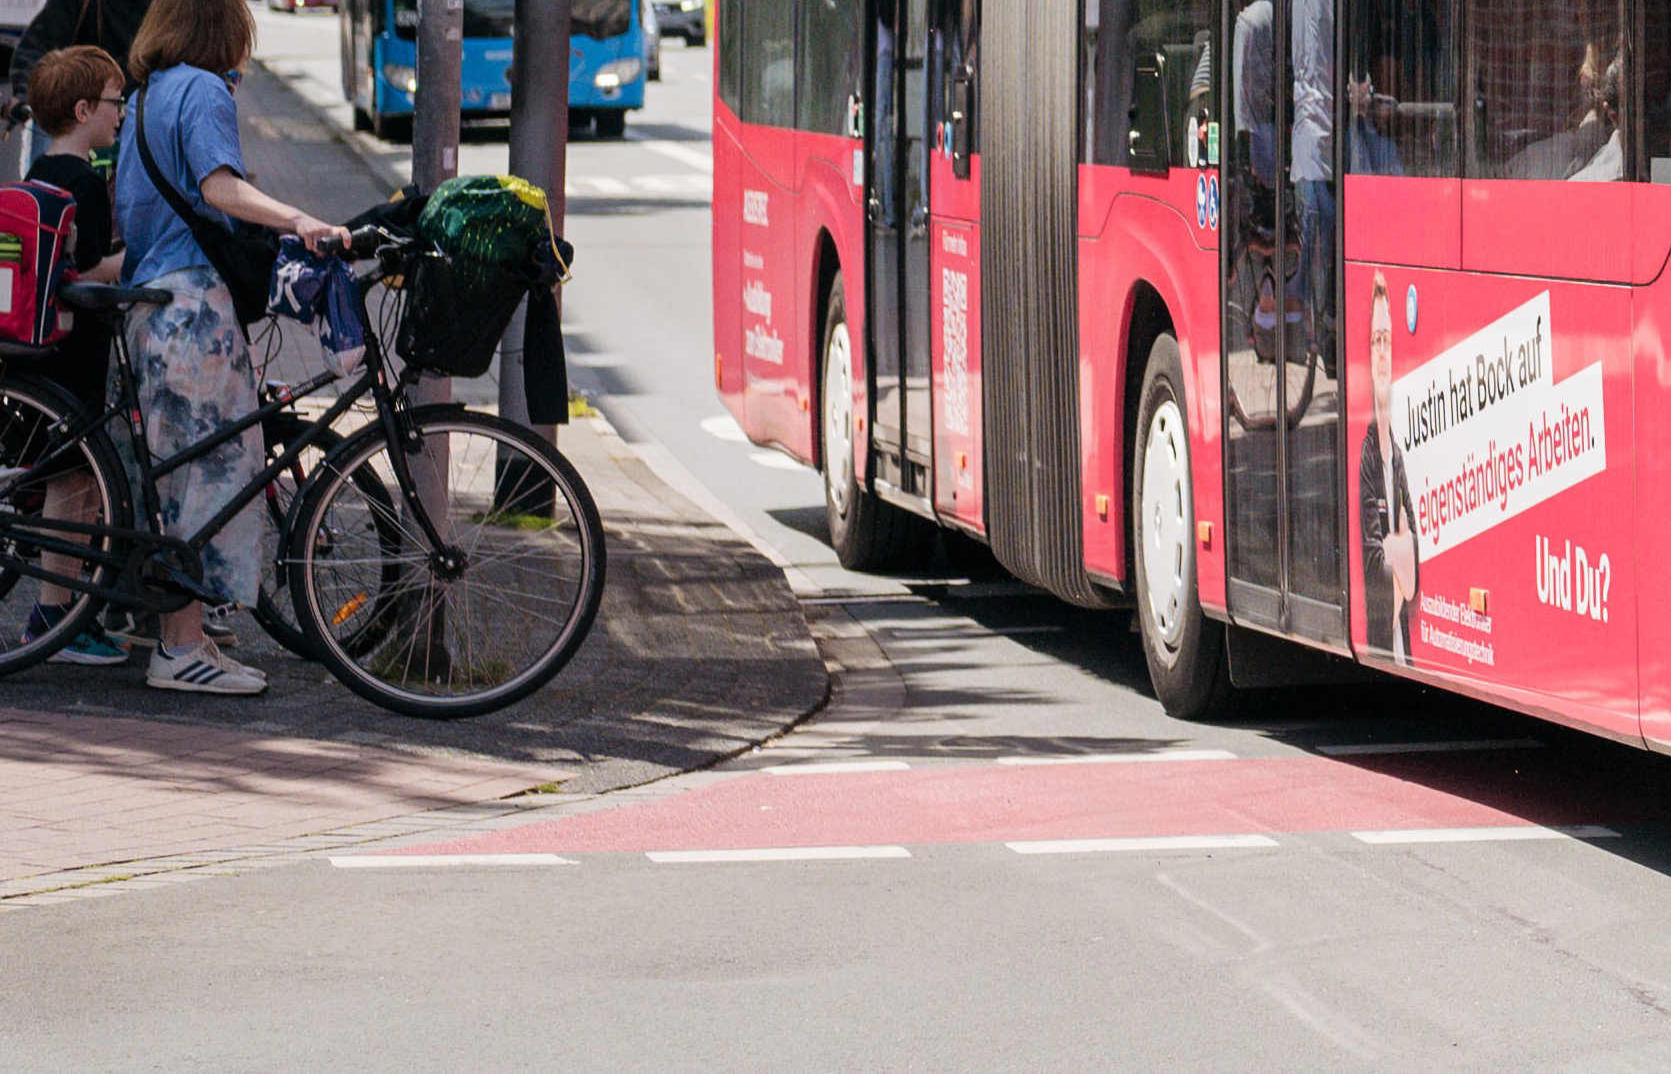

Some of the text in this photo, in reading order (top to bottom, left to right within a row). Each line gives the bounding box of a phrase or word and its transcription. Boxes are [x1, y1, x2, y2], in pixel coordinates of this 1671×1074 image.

[1404, 315, 1542, 452] Justin hat Bock auf
[1418, 401, 1595, 545] eigenständiges Arbeiten.
[1535, 534, 1610, 623] Und Du?
